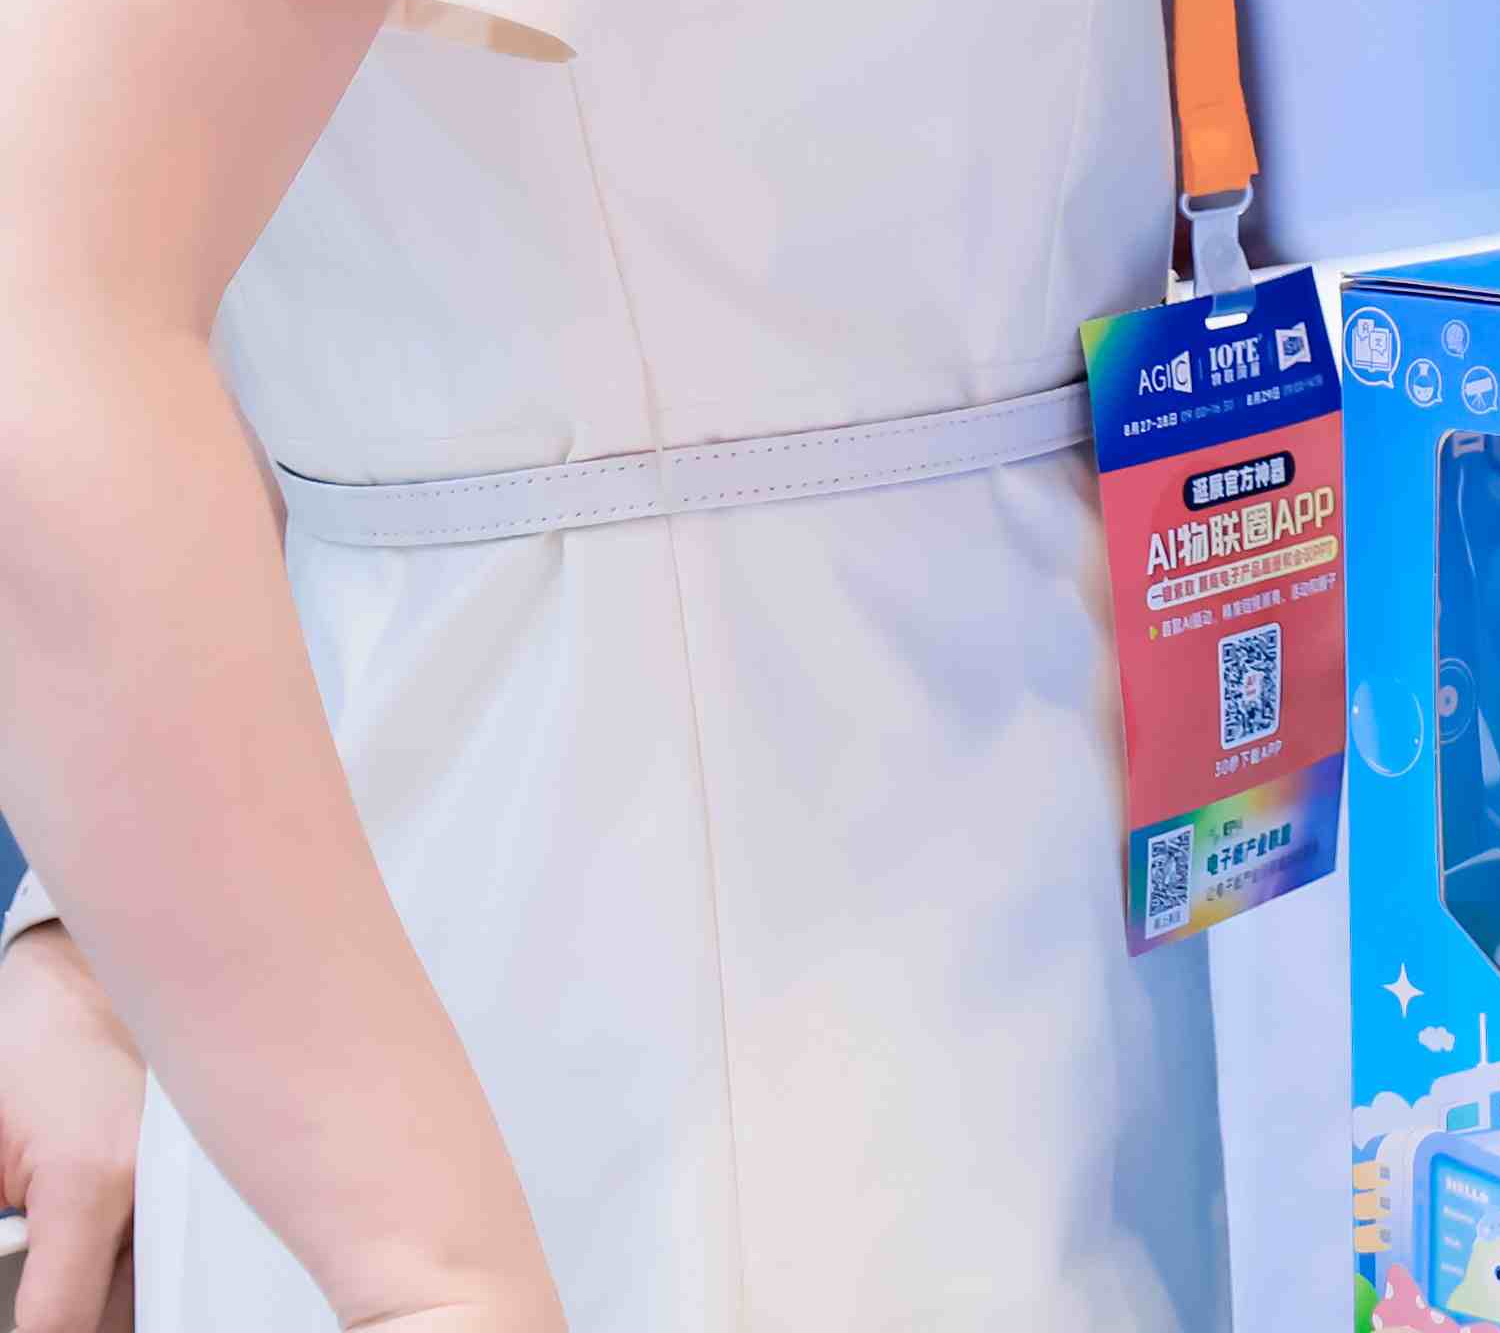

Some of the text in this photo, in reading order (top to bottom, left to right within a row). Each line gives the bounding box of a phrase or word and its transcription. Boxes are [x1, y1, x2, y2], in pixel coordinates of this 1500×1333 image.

[1139, 350, 1193, 395] AGIC
[1208, 336, 1261, 372] IOTE
[1192, 456, 1286, 505] 逛展官方神器
[1147, 486, 1334, 575] AI物联圈APP
